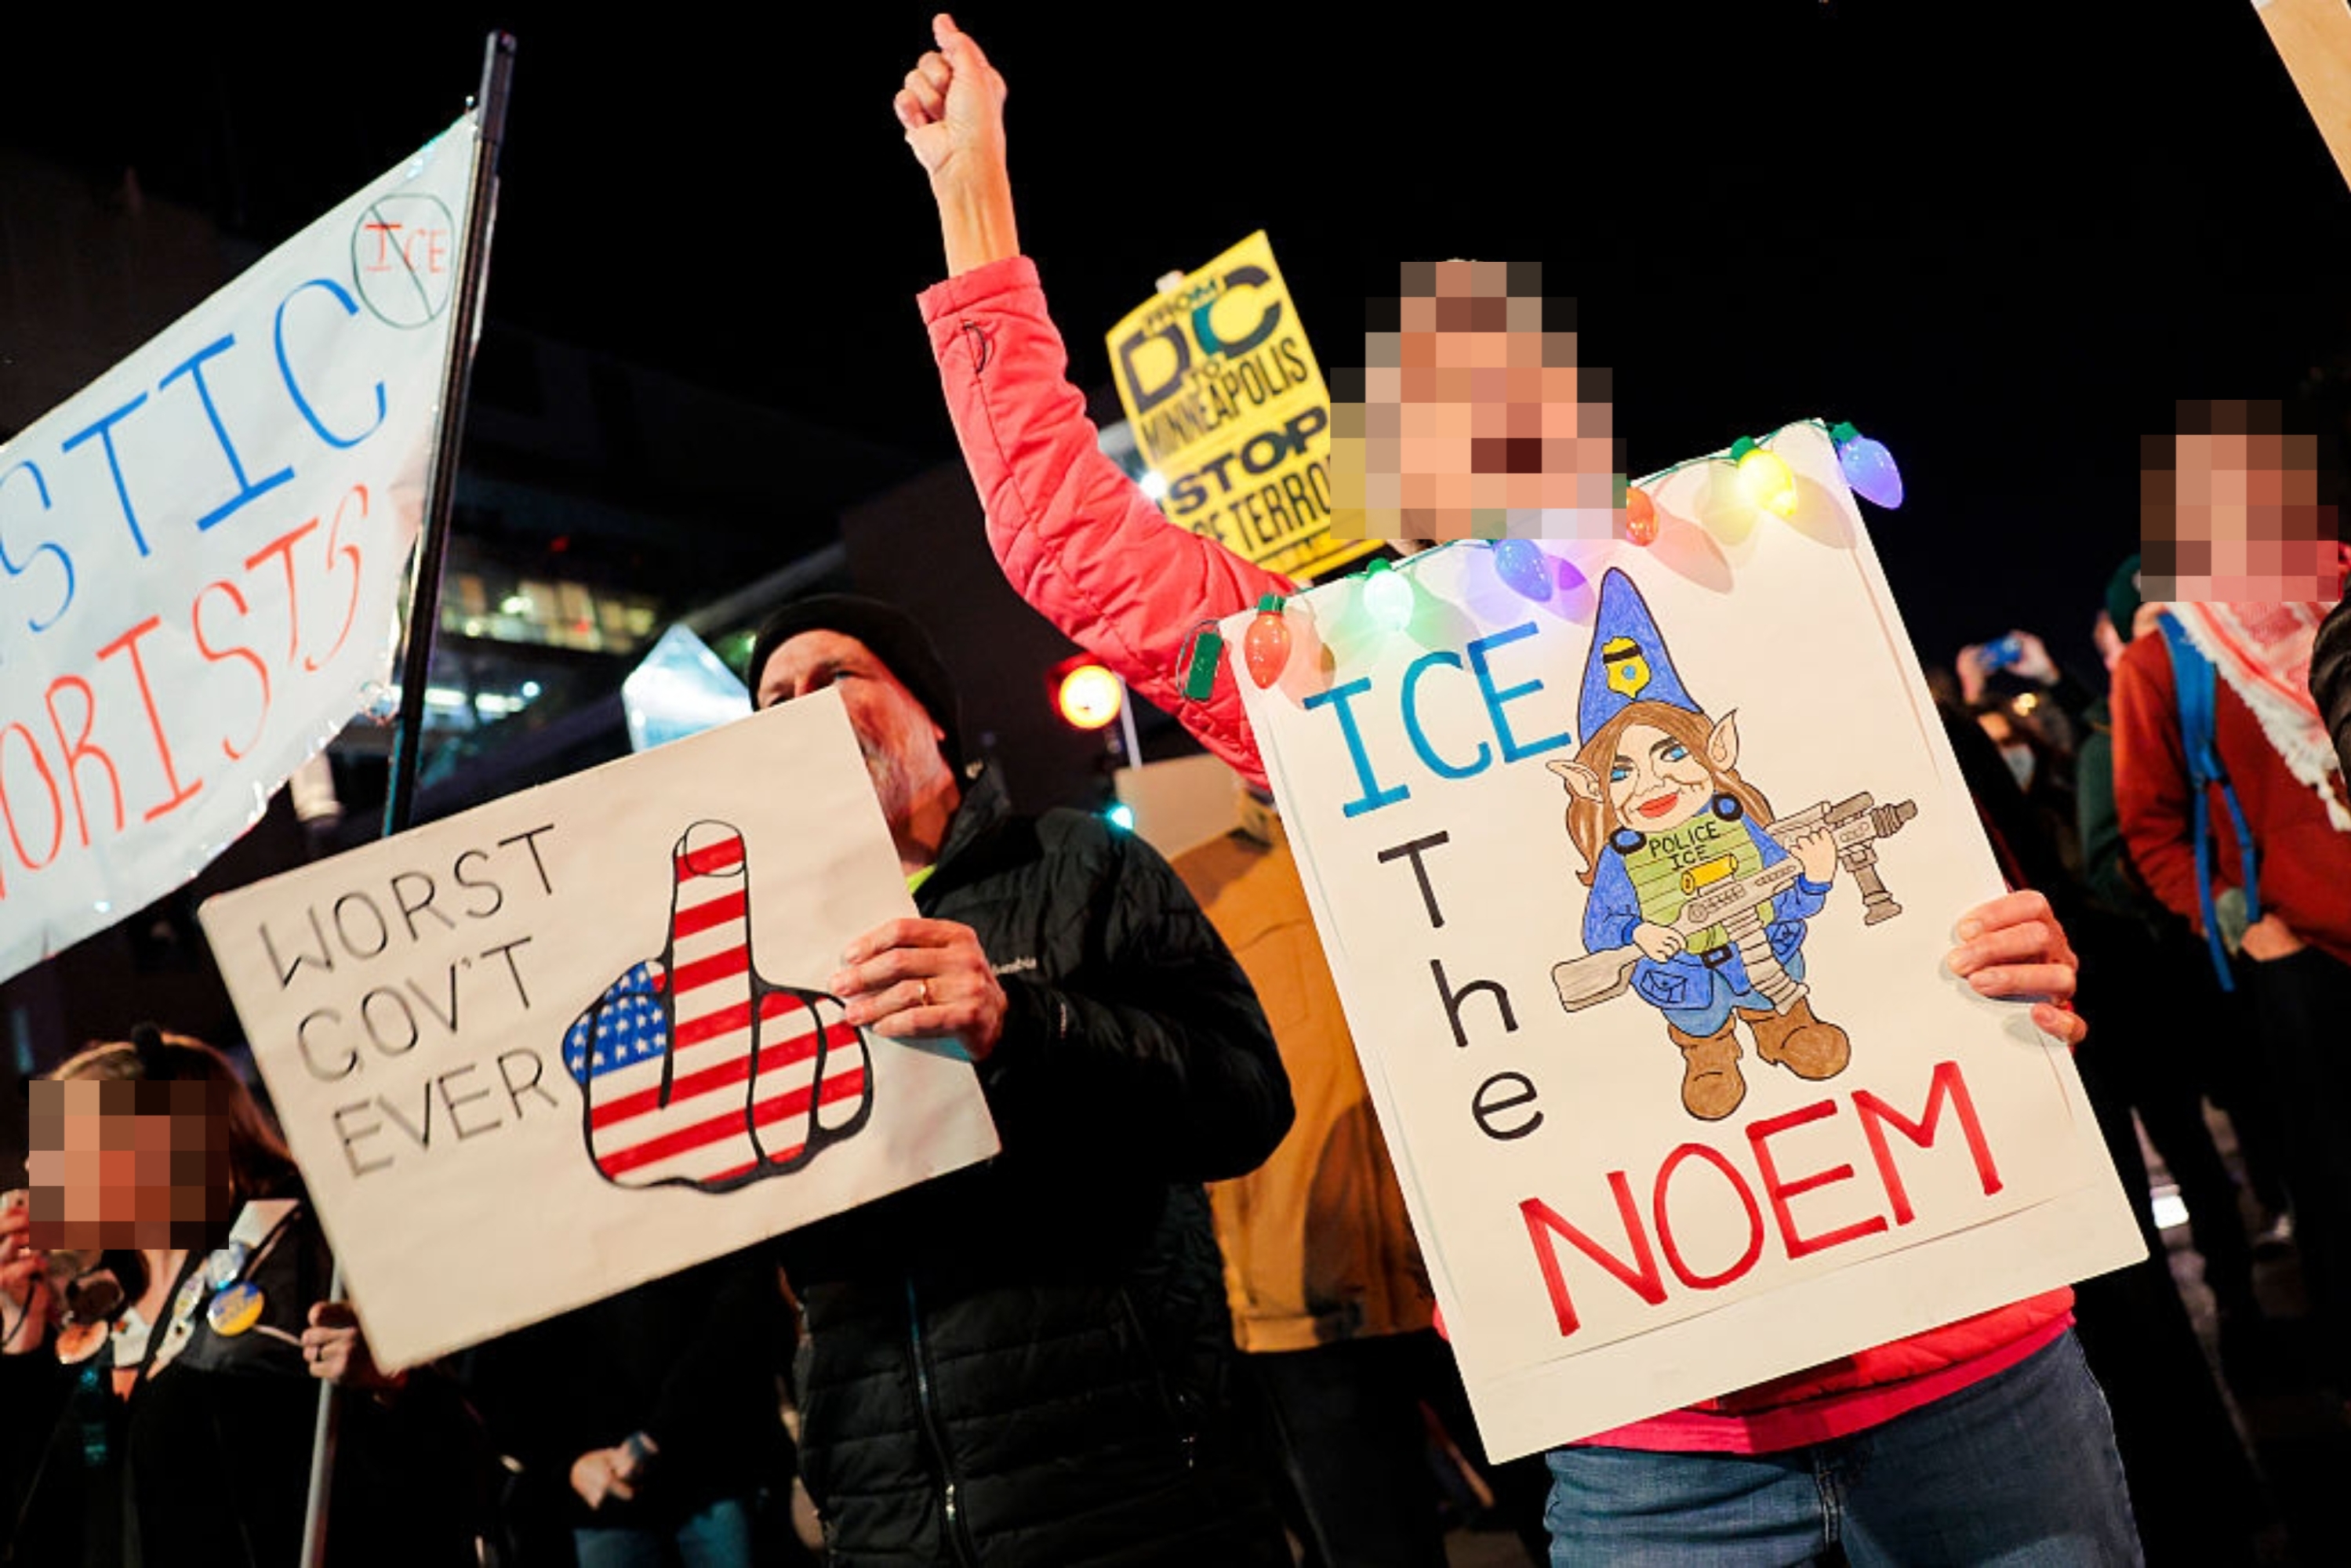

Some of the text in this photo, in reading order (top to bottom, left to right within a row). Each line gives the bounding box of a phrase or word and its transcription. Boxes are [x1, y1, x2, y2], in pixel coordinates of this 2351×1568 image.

[364, 223, 446, 274] ICE
[1118, 265, 1282, 414] DC
[1141, 337, 1308, 463] MINNEAPOLIS
[1168, 405, 1328, 515] STOP
[1228, 454, 1331, 551] TERRO
[0, 484, 368, 901] ORISTS
[1303, 621, 1572, 818] ICE
[1648, 819, 1721, 858] POLICE
[1668, 844, 1710, 873] ICE
[259, 823, 554, 990] WORST
[1377, 829, 1544, 1142] The
[332, 1047, 558, 1177] EVER
[1517, 1060, 2004, 1337] NOEM
